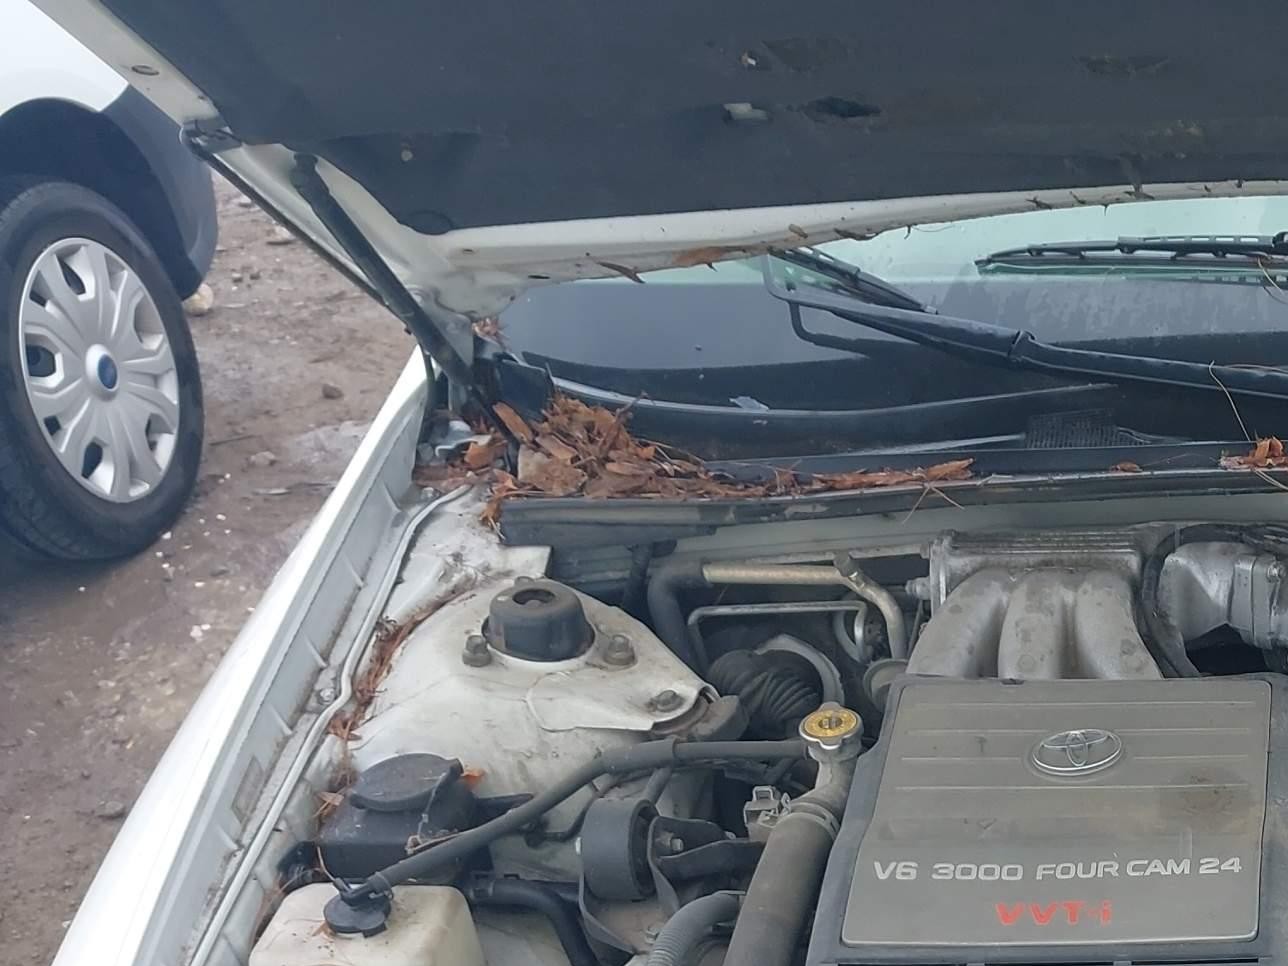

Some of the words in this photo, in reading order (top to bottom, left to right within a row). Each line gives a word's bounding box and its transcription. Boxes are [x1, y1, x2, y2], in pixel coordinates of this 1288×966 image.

[873, 860, 919, 881] V6
[931, 862, 1025, 881] 3000
[1036, 861, 1119, 880] FOUR
[1126, 858, 1191, 877] CAM
[1199, 856, 1242, 875] 24
[994, 899, 1112, 926] VVT-i
